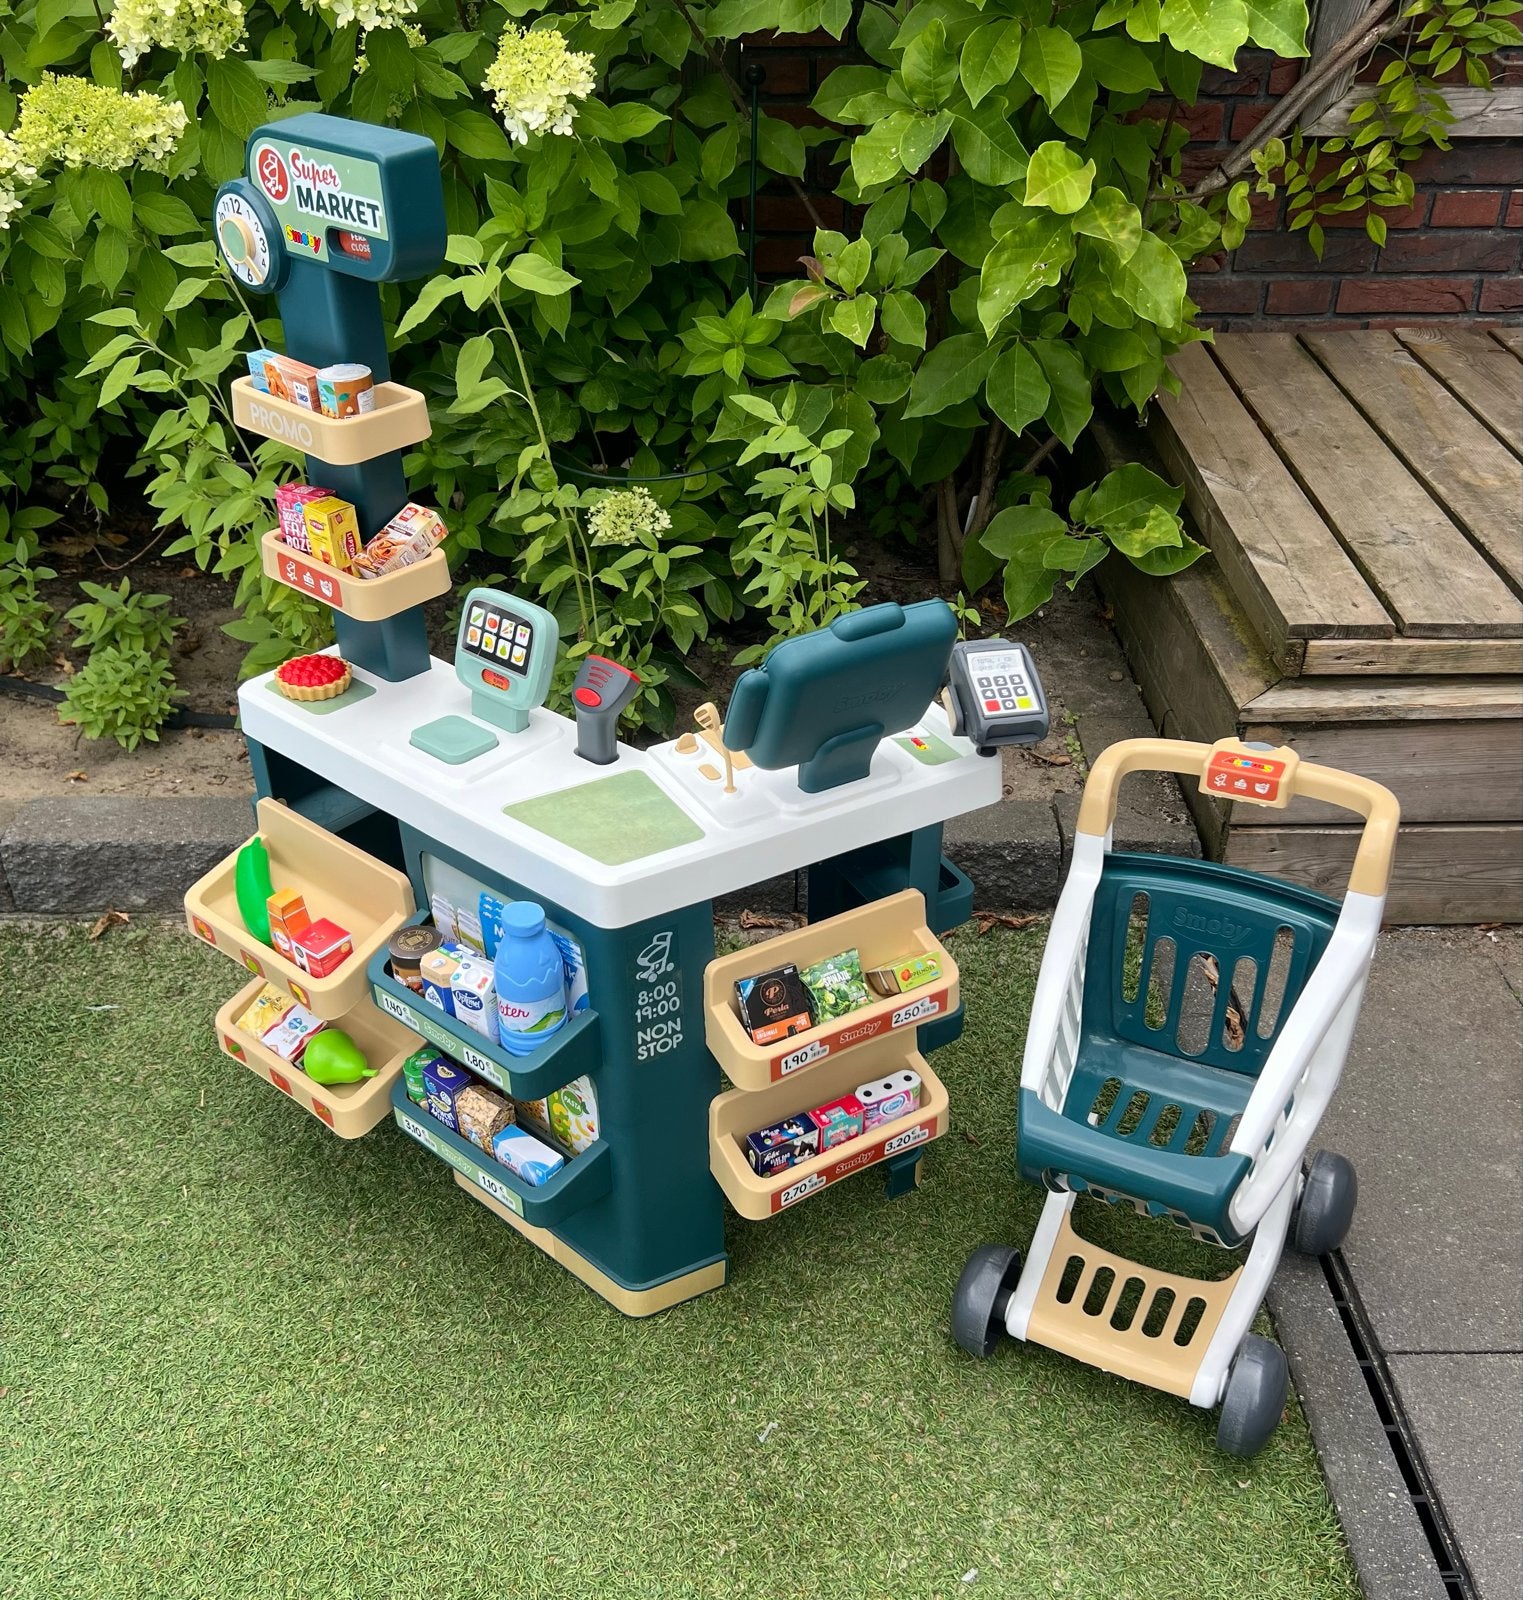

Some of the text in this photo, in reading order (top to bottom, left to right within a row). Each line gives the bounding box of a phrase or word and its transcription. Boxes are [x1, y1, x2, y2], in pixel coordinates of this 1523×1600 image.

[291, 152, 340, 190] Super
[222, 201, 230, 213] 11
[229, 198, 242, 215] 12
[296, 185, 380, 228] MARKET
[254, 222, 260, 233] 2
[285, 225, 322, 254] Smoby
[259, 237, 267, 254] 3
[247, 267, 253, 283] 6
[250, 402, 313, 448] PROMO
[346, 532, 356, 558] LIPTON
[996, 677, 1005, 685] 2
[1016, 687, 1025, 695] 6
[1174, 906, 1253, 946] Smoby
[454, 990, 482, 1010] Optimel
[638, 981, 677, 1006] 8:00
[498, 1001, 530, 1019] ater
[635, 996, 680, 1024] 19:00
[764, 1003, 790, 1017] Perla
[637, 1017, 681, 1045] NON
[839, 1020, 882, 1044] Smoby
[637, 1033, 683, 1060] STOP
[563, 1093, 582, 1111] PASTA
[835, 1150, 875, 1174] Smoby
